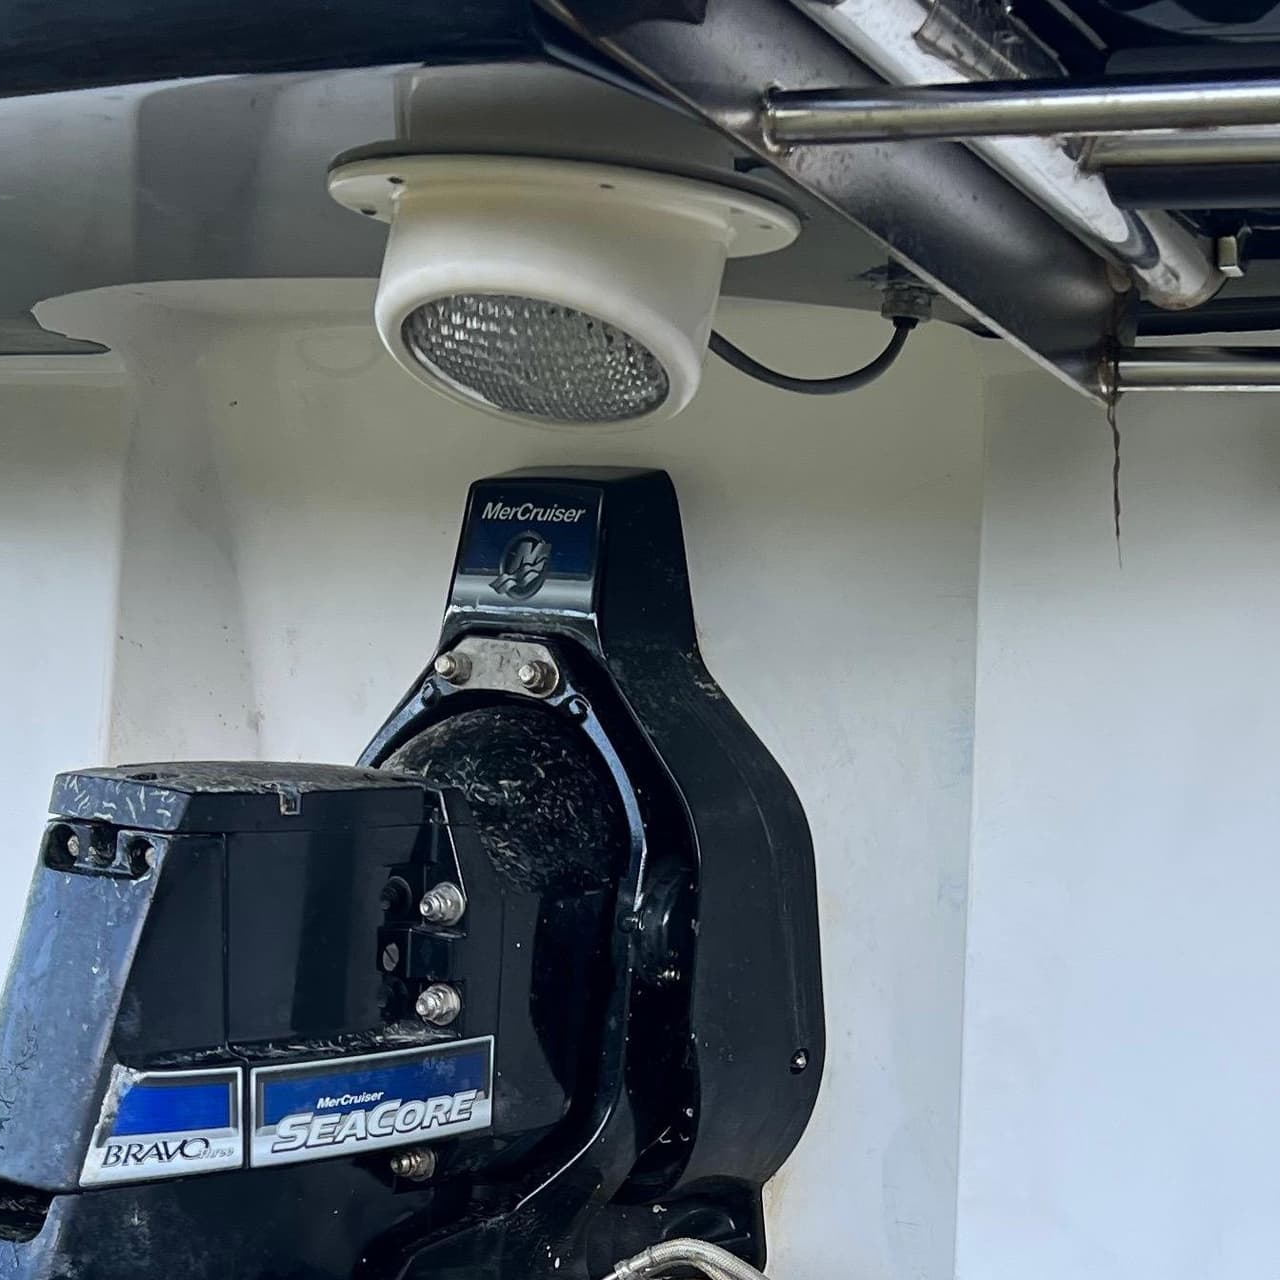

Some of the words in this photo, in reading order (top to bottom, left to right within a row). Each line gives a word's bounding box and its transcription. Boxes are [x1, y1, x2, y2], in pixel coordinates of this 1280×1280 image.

[481, 502, 586, 522] MerCruiser
[316, 1091, 384, 1109] MerCruiser
[271, 1089, 477, 1153] SEACORE
[101, 1138, 209, 1168] BRAVO
